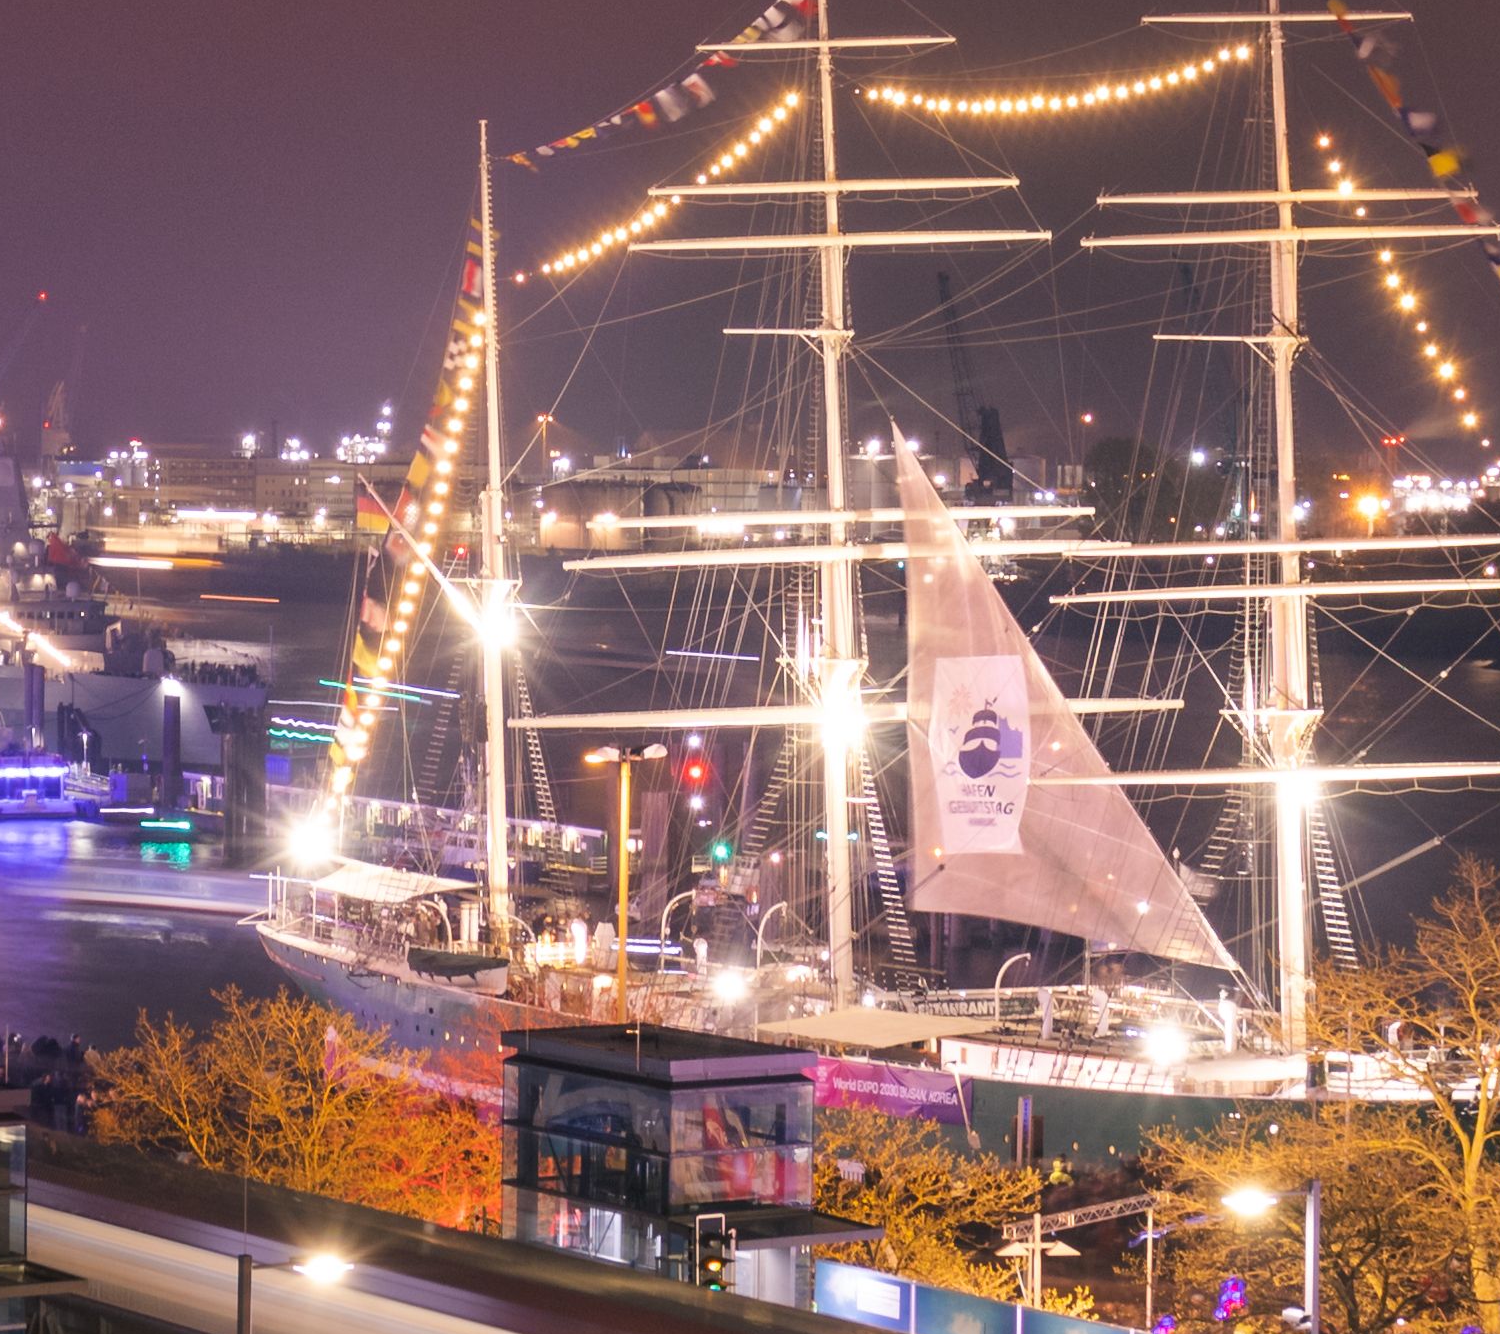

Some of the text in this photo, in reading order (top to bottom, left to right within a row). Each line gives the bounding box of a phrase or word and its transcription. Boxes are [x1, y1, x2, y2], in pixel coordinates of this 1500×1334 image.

[832, 1076, 857, 1092] World
[857, 1079, 879, 1094] EXPO
[879, 1082, 899, 1098] 2030
[928, 1091, 959, 1106] KOREA
